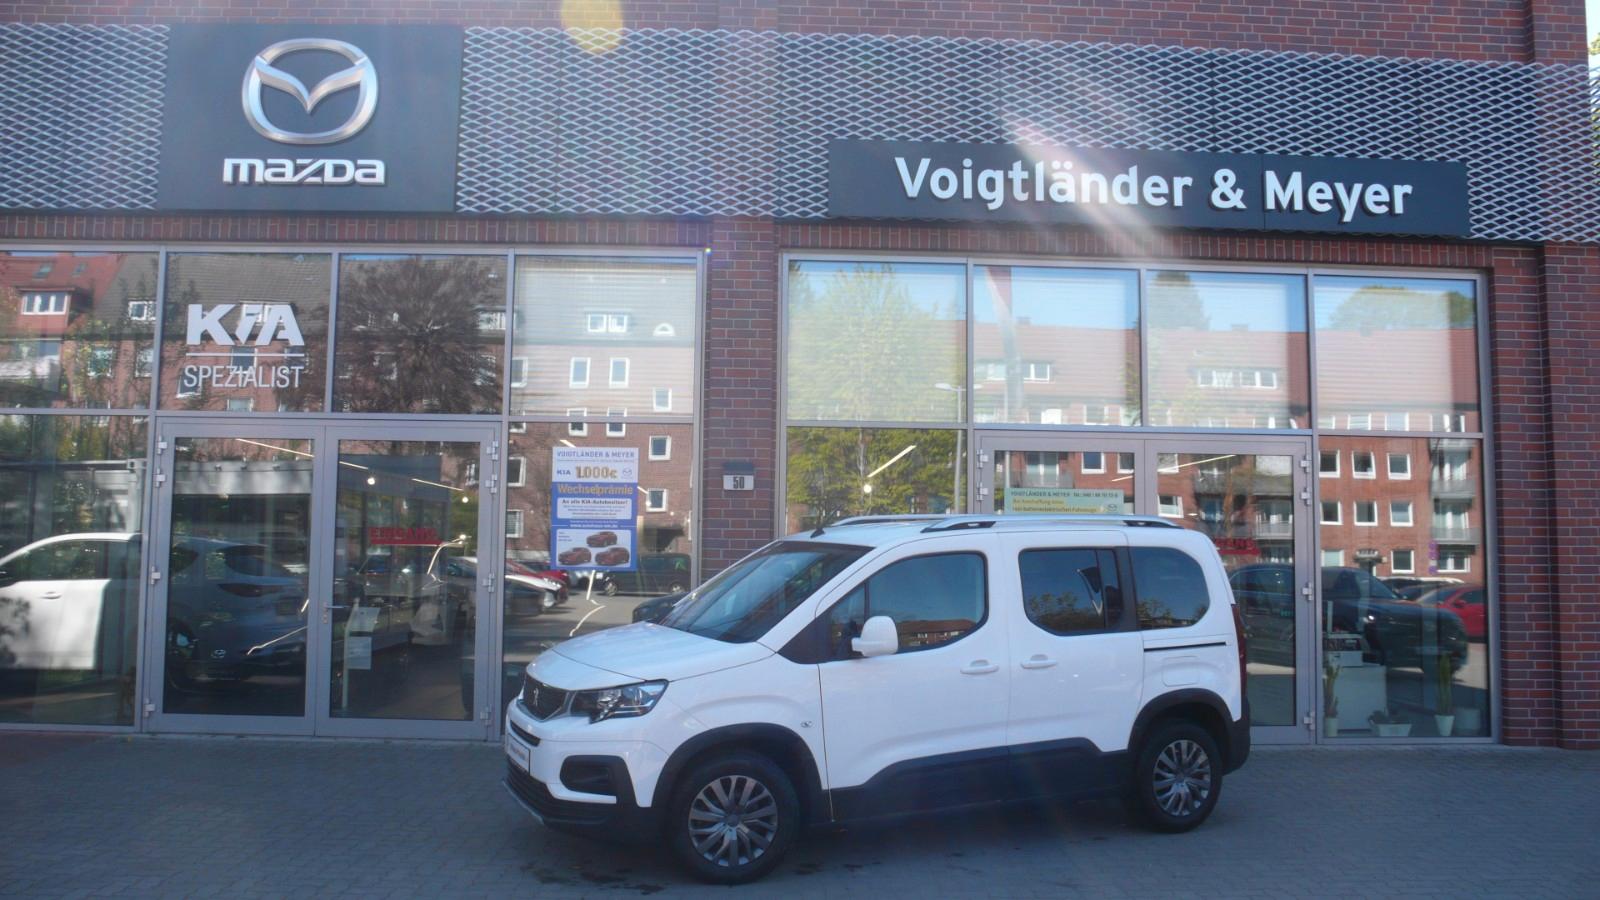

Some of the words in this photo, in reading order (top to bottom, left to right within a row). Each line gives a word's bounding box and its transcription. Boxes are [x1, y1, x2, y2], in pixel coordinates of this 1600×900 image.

[895, 156, 1193, 211] Voigtländer
[1210, 168, 1247, 209] &
[1265, 170, 1413, 223] Meyer
[186, 303, 305, 345] KIA
[183, 364, 305, 388] SPEZIALIST
[557, 483, 633, 496] Wechselprämie
[733, 476, 745, 489] 50
